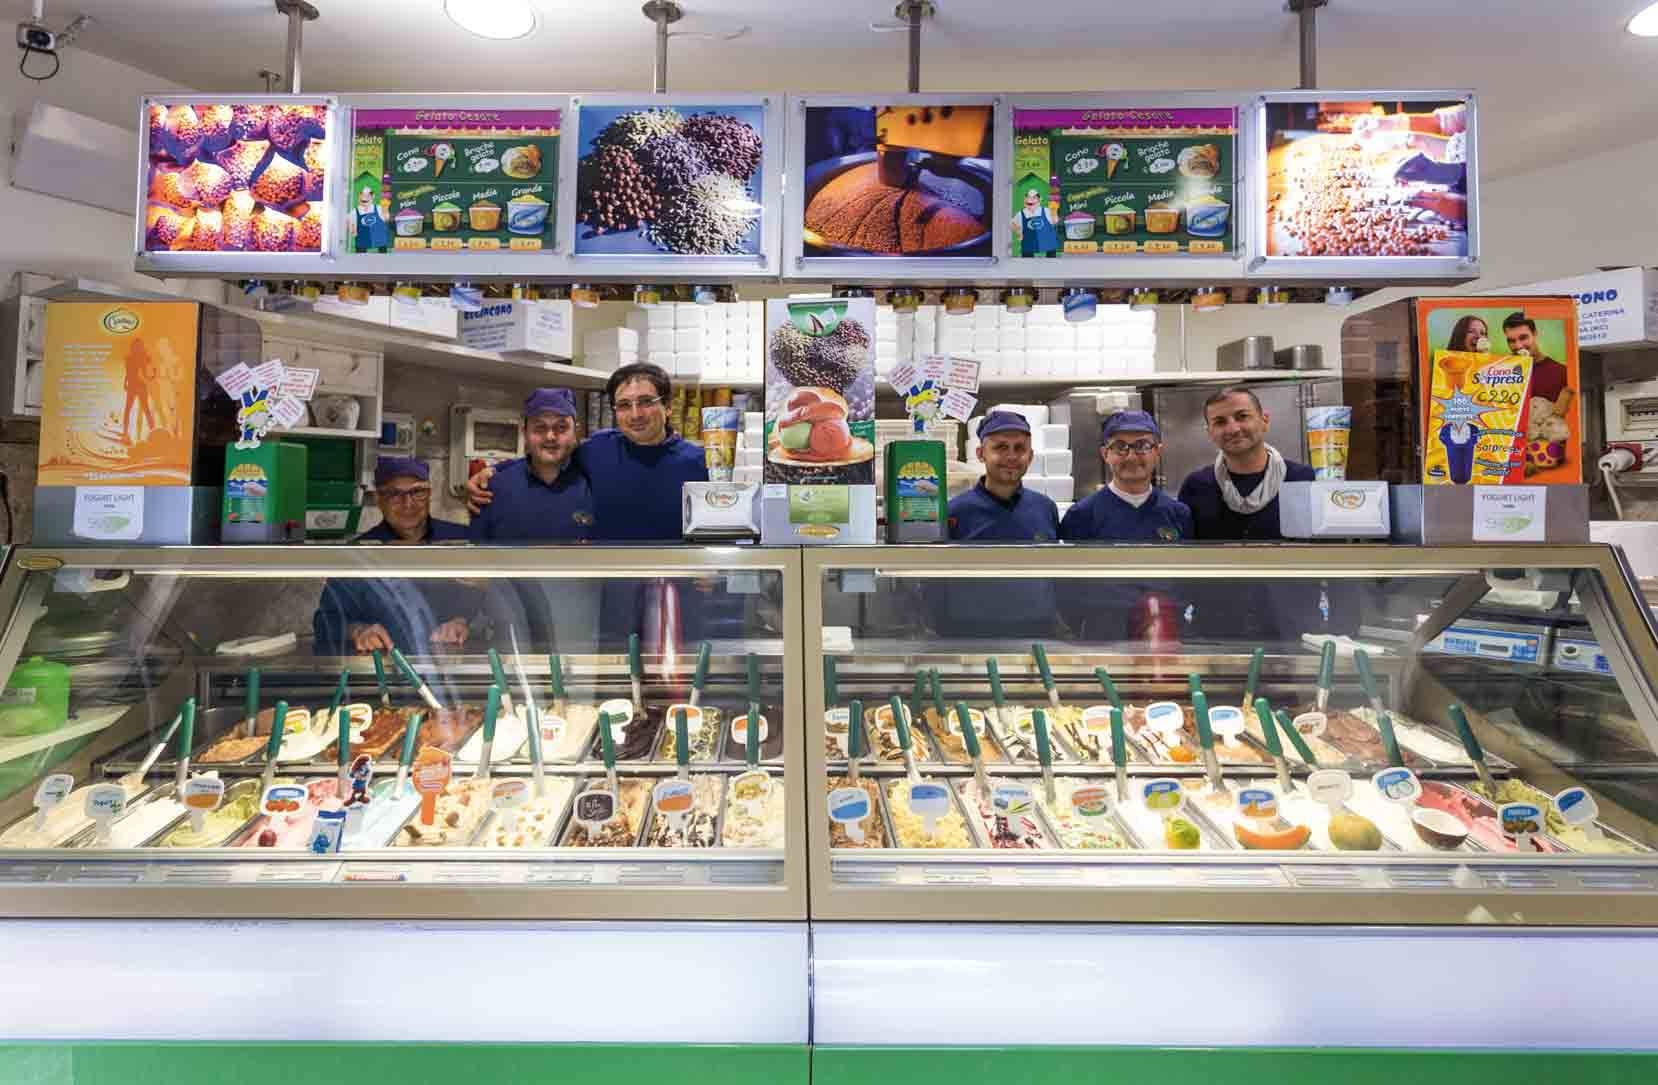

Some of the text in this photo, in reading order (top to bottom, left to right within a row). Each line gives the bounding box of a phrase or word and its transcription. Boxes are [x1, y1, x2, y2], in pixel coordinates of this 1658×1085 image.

[415, 111, 455, 121] Gelato
[1082, 110, 1125, 121] Gelato
[352, 135, 383, 145] Gelato
[1014, 135, 1049, 146] Gelato
[396, 147, 420, 161] Cono
[1064, 148, 1089, 162] Cono
[431, 190, 461, 204] Piccola
[472, 189, 498, 201] Media
[1103, 192, 1136, 206] Piccola
[1487, 366, 1512, 376] Cono
